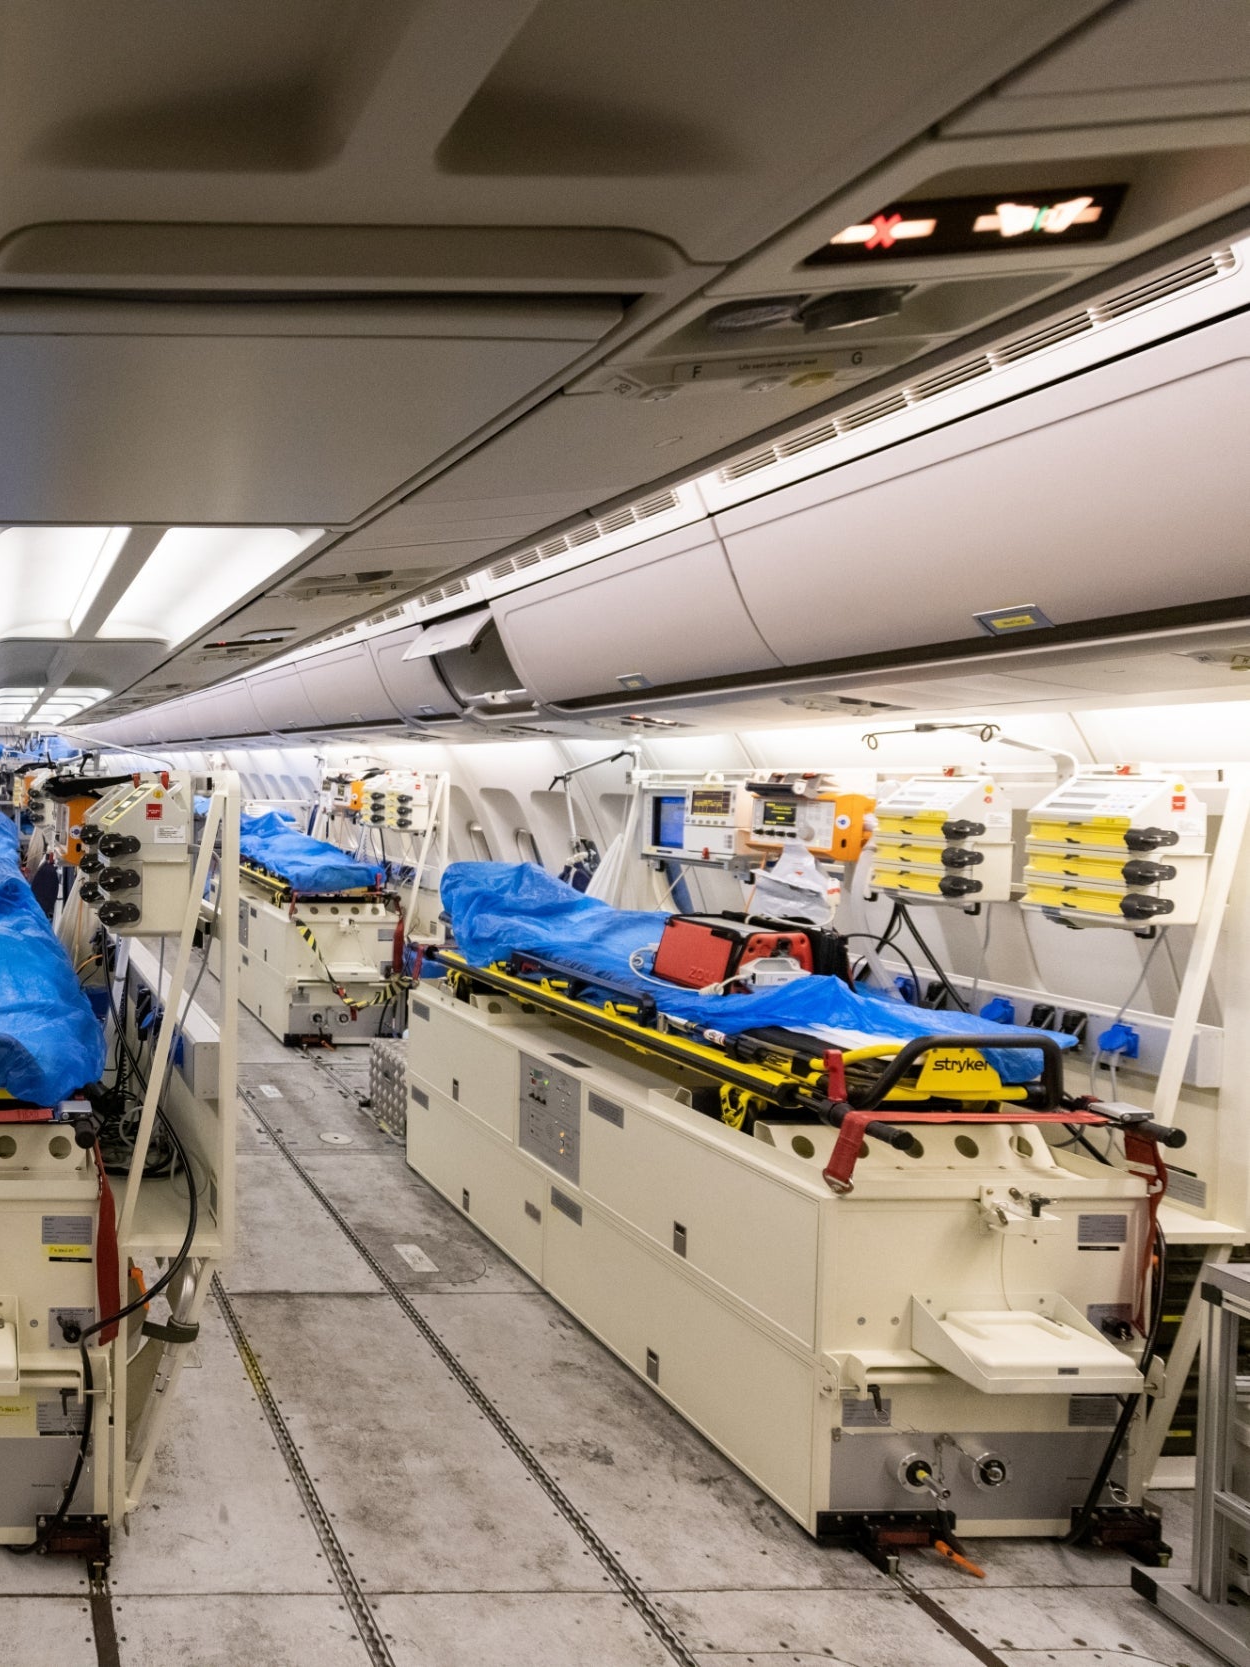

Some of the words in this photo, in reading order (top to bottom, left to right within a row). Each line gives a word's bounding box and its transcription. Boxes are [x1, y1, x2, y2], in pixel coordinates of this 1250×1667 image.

[851, 351, 863, 365] G
[692, 365, 702, 379] F
[614, 382, 632, 396] 29
